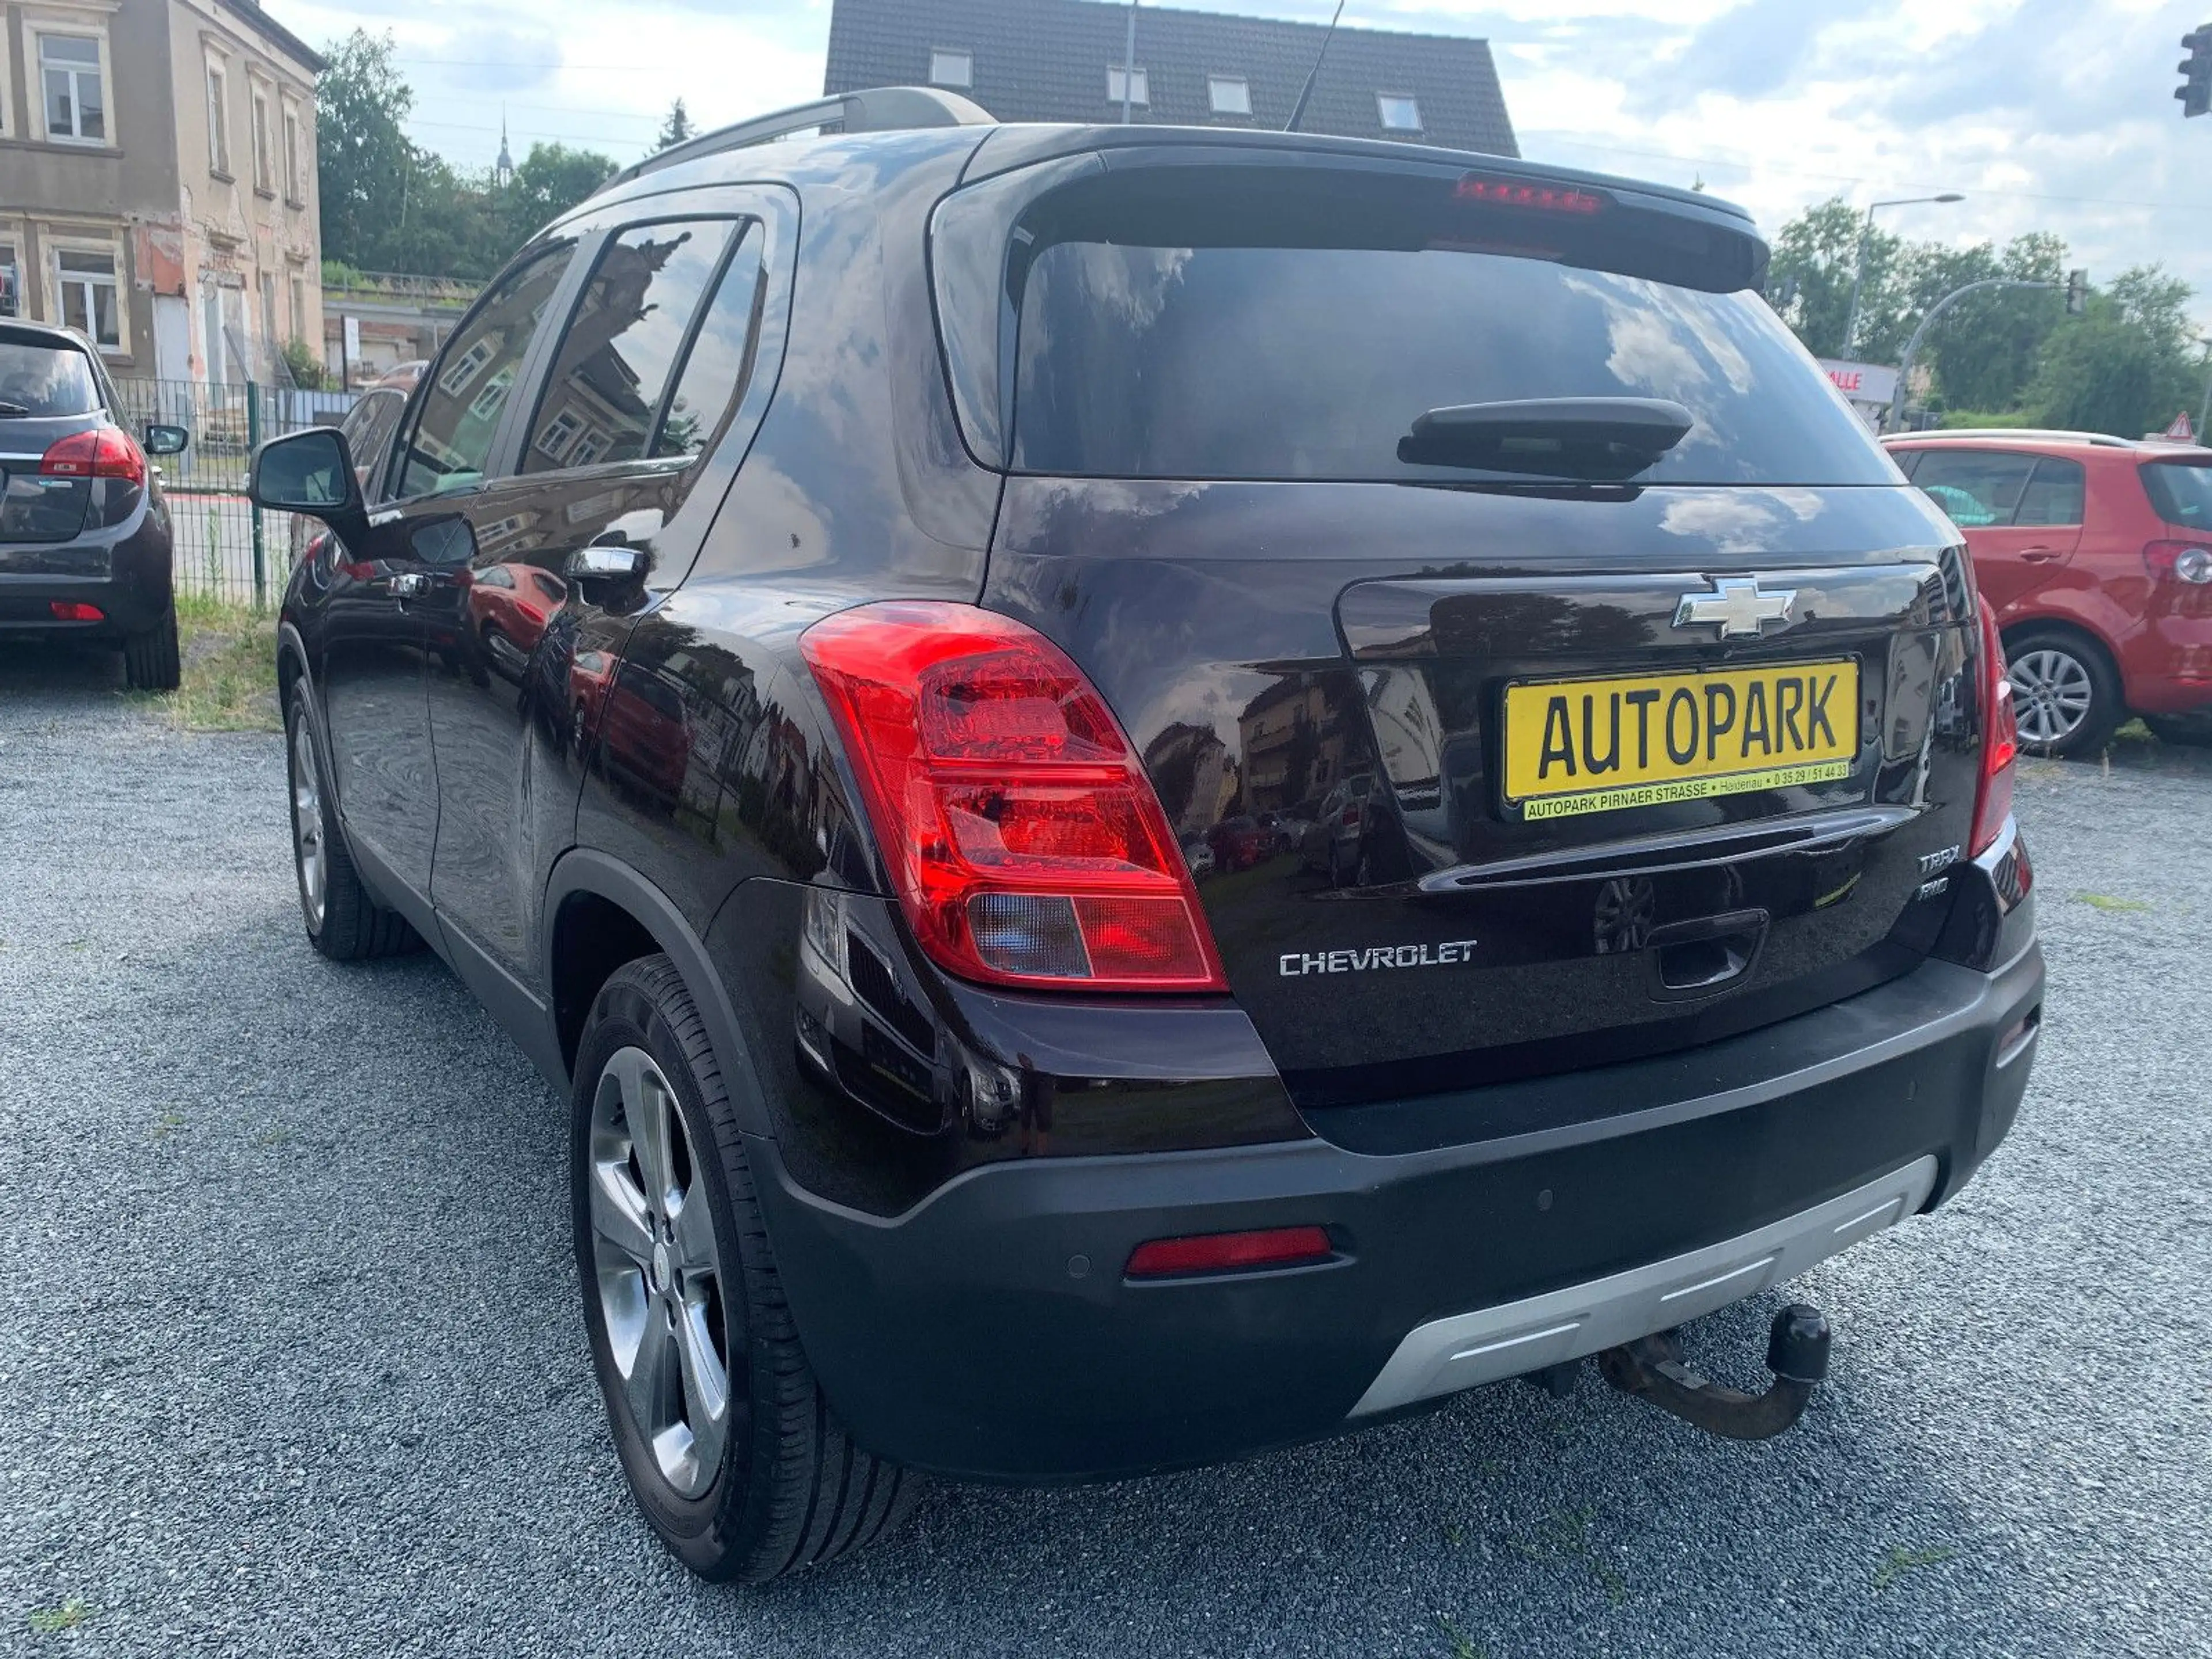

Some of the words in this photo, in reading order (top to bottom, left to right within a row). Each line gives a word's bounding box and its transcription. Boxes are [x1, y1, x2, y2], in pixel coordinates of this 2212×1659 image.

[1539, 675, 1838, 779] AUTOPARK
[1527, 797, 1597, 817] AUTOPARK
[1600, 790, 1653, 808] PIRNAER
[1656, 782, 1707, 801] STRASSE
[1916, 844, 1960, 873] TRAX
[1280, 940, 1478, 976] CHEVROLET
